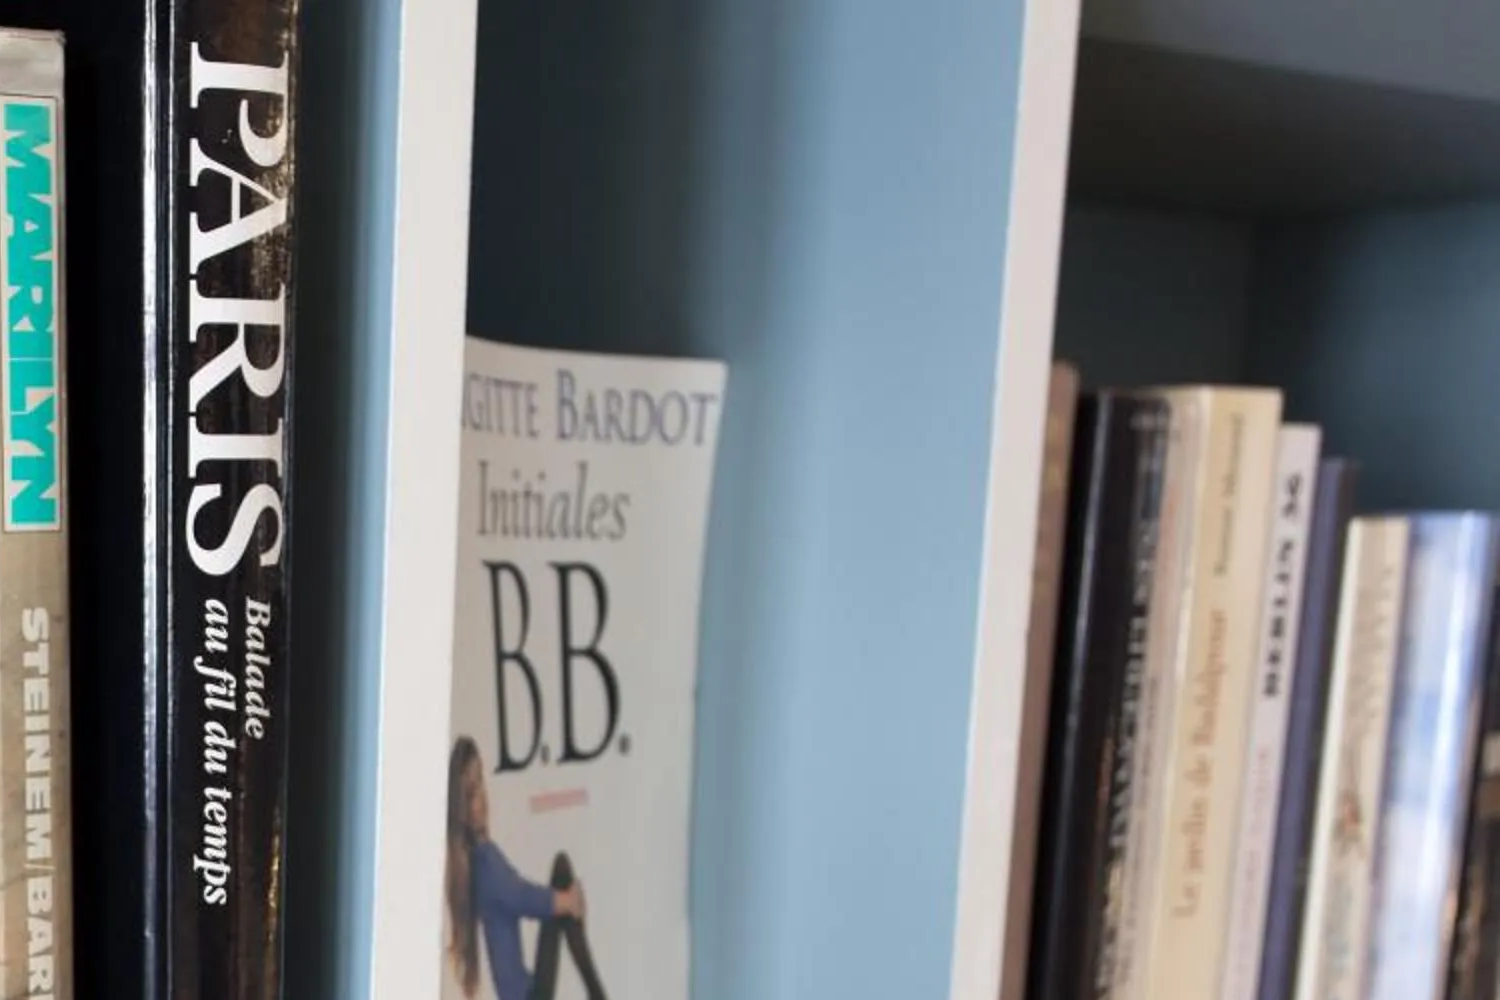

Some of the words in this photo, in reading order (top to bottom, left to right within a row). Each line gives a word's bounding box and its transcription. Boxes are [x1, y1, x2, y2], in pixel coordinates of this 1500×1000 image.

[3, 103, 58, 528] MARILYN
[185, 41, 290, 577] PARIS
[556, 368, 719, 447] BARDOT
[477, 460, 631, 541] Initiales
[204, 599, 230, 653] au
[193, 656, 237, 711] fil
[245, 596, 271, 740] Balade
[204, 720, 237, 775] du
[193, 786, 233, 906] temps
